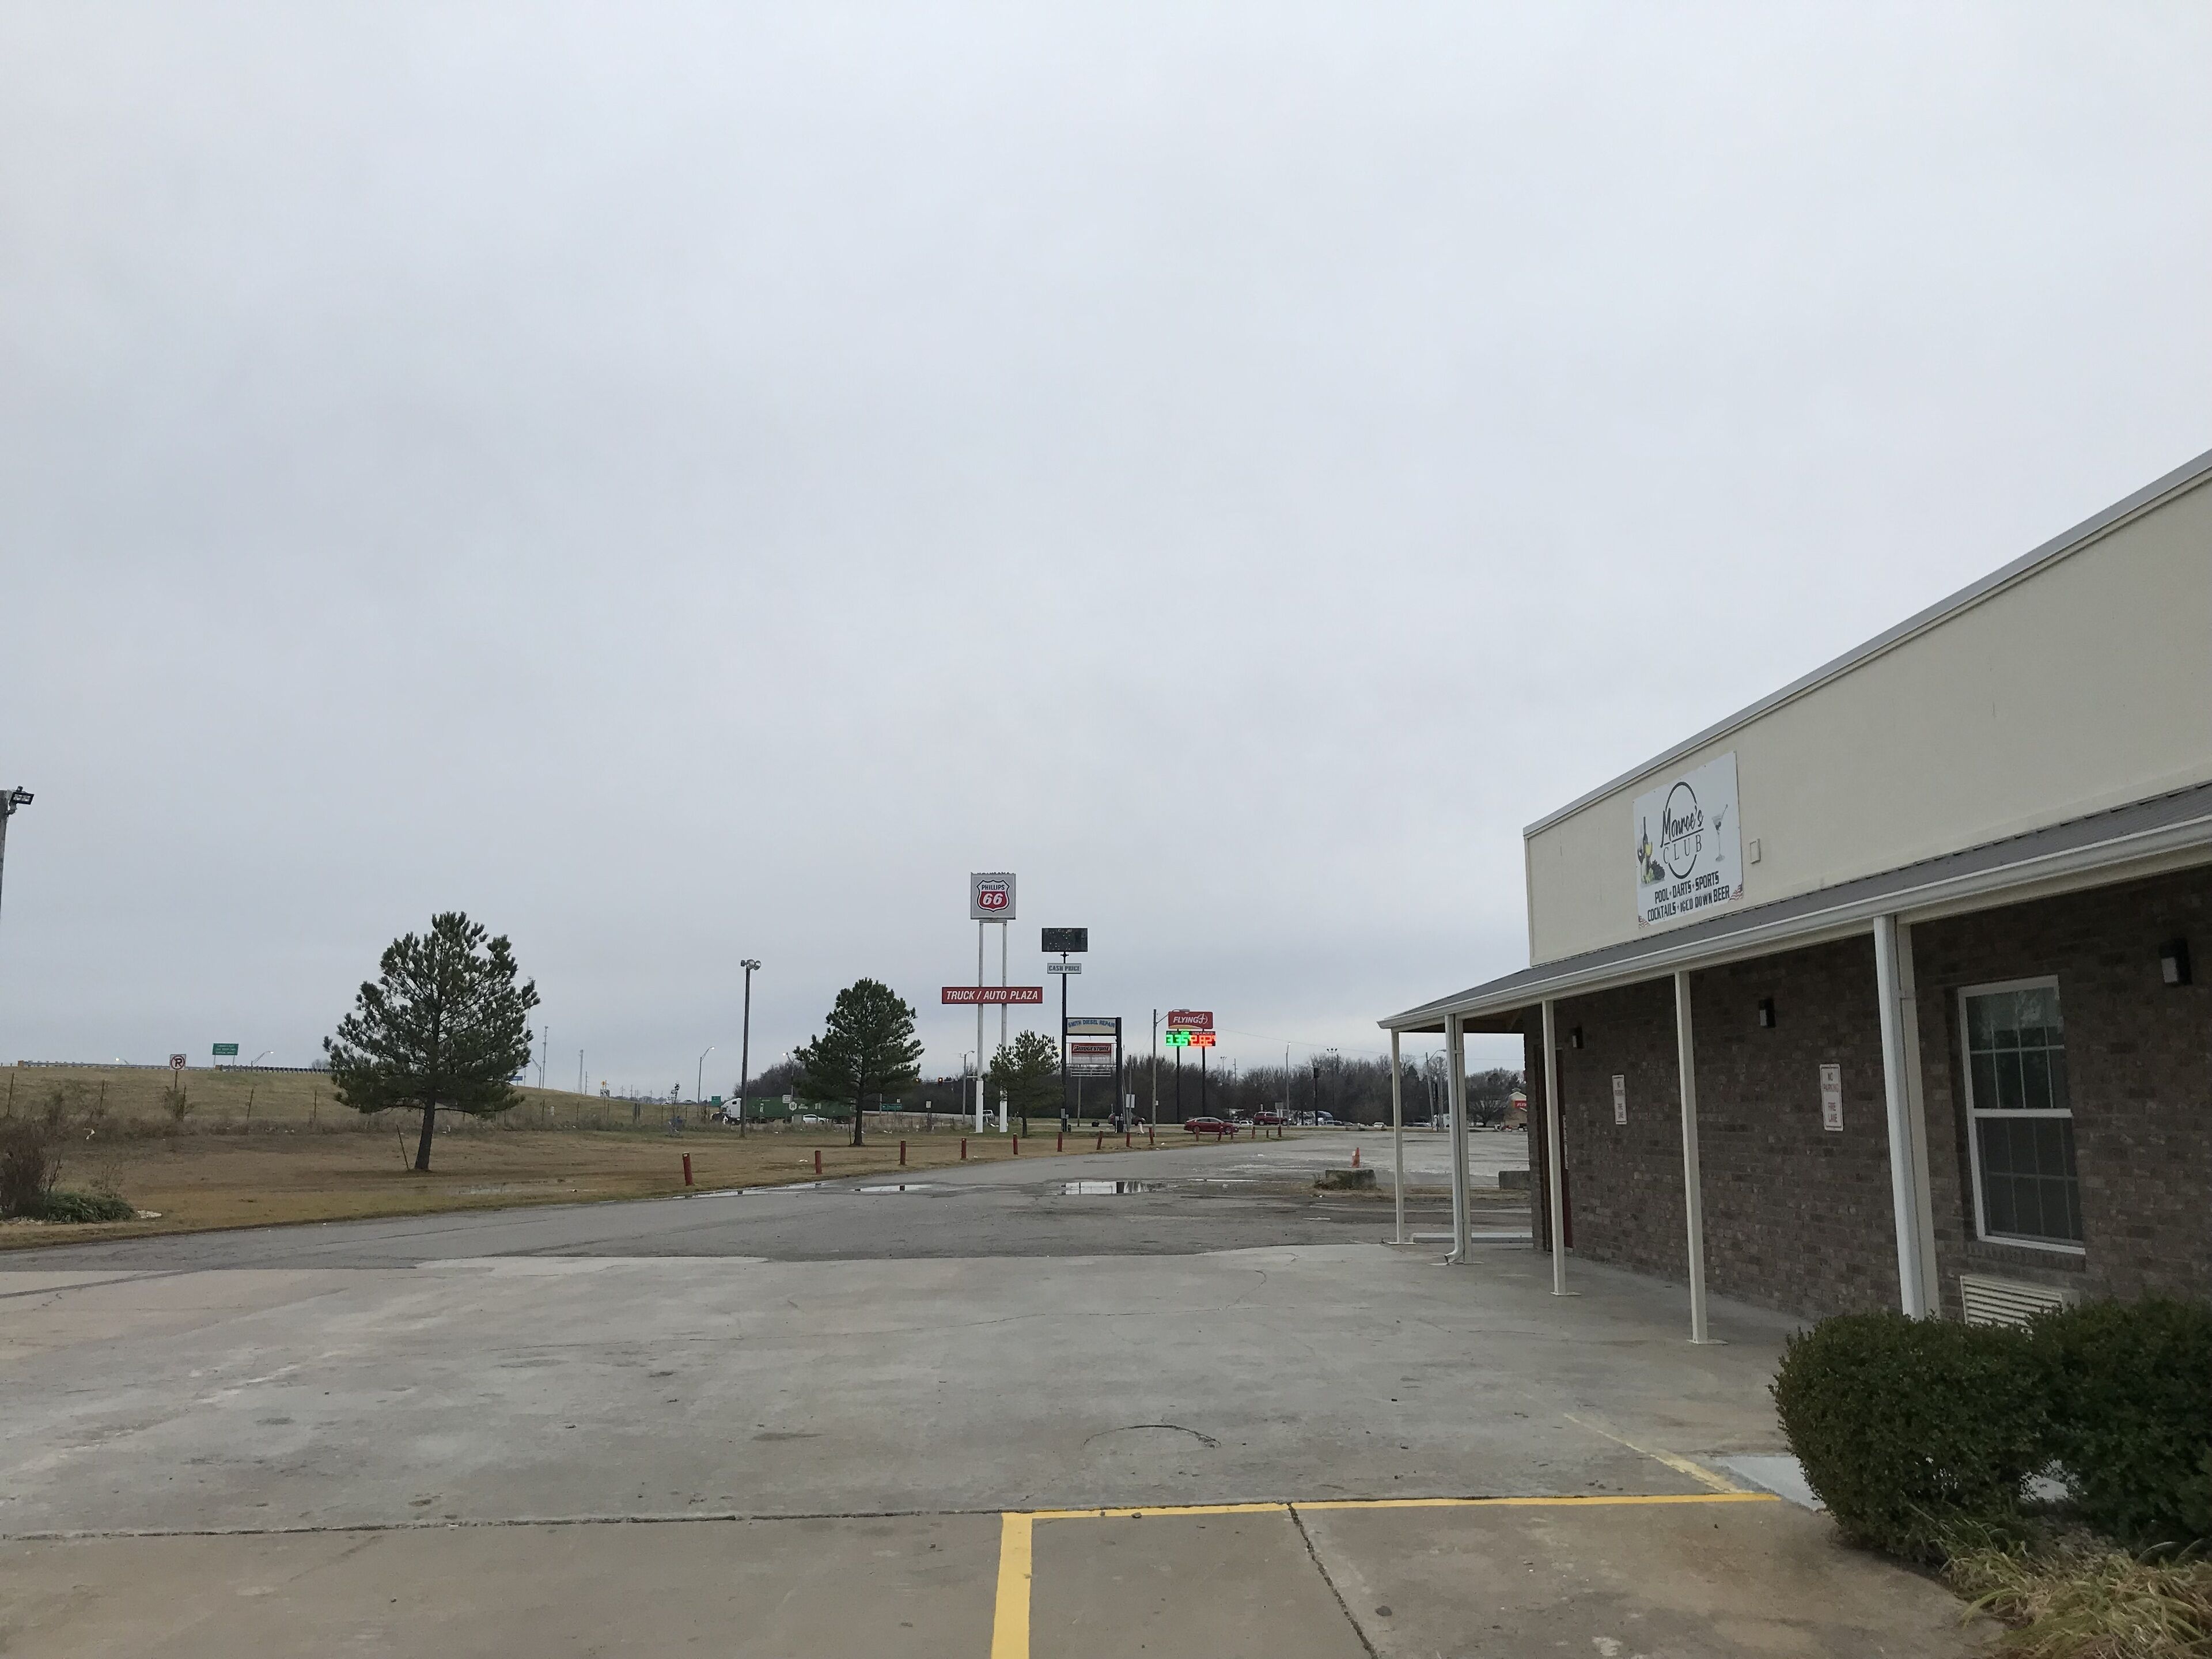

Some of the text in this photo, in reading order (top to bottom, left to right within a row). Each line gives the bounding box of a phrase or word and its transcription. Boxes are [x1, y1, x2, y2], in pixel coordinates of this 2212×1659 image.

[1660, 805, 1704, 848] Monroe's
[1663, 834, 1702, 864] CLUB
[983, 893, 1003, 905] 66
[1655, 870, 1719, 904] POOL DARTS SPORTS
[1647, 885, 1730, 922] COCKTAILS ICED DOWN BEER
[946, 991, 975, 1000] TRUCK
[983, 991, 1006, 999] AUTO
[1009, 990, 1038, 999] PLAZA
[1099, 1020, 1115, 1028] REPAIR
